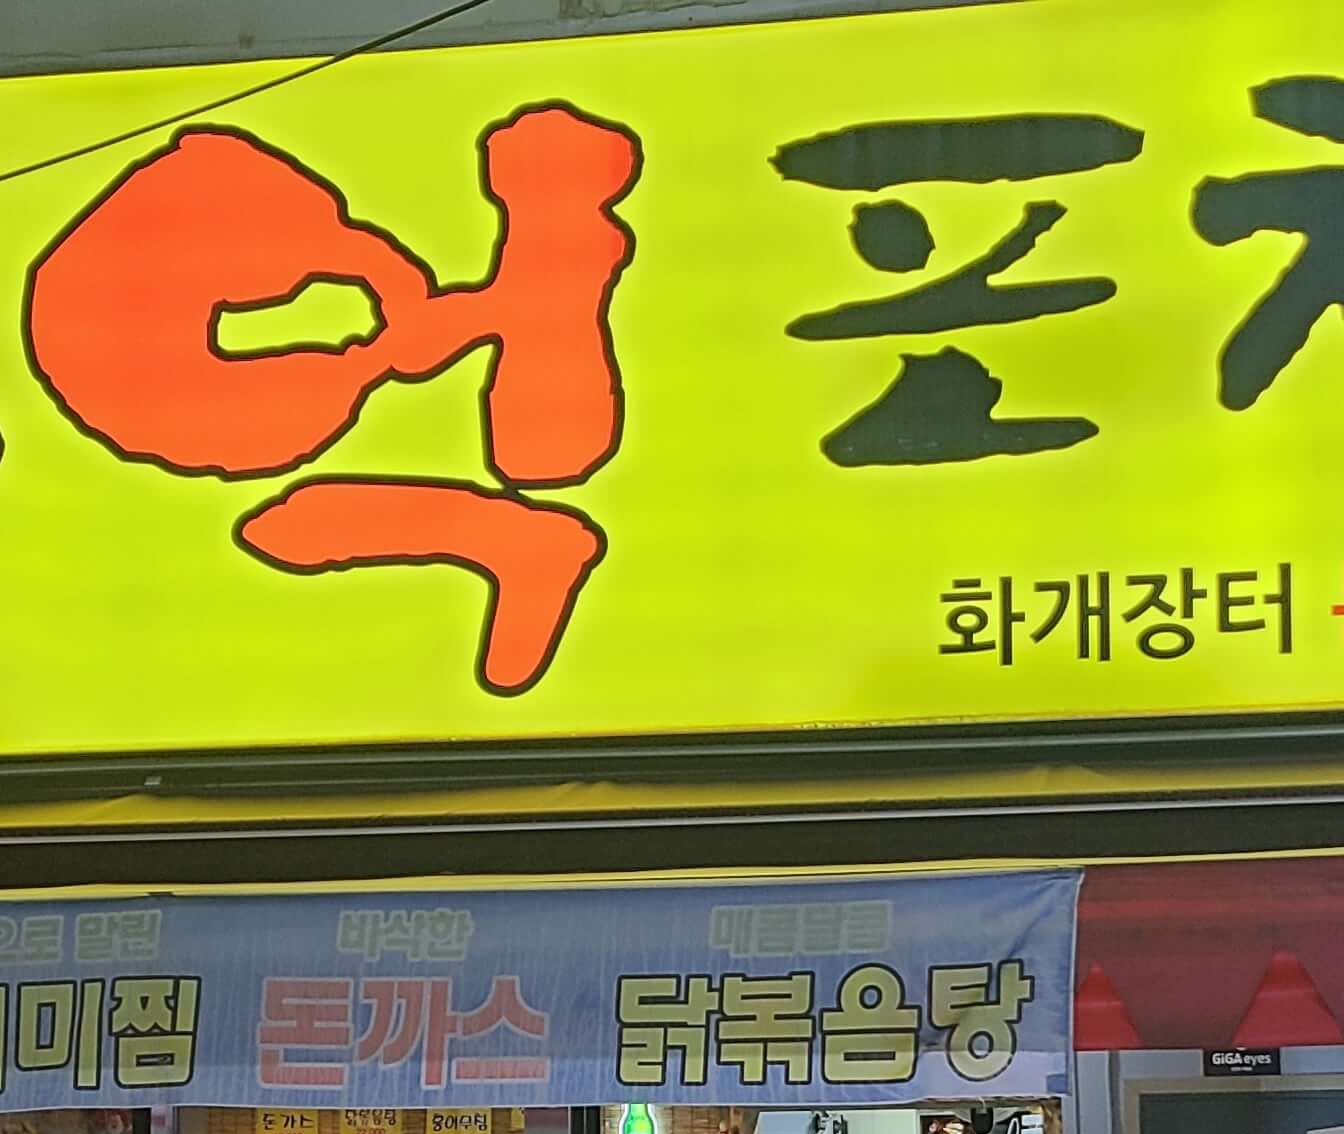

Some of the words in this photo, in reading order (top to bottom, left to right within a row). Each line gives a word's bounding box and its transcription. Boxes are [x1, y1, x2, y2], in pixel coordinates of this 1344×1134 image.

[940, 563, 1293, 666] 화개장터
[74, 909, 162, 962] 말린
[336, 907, 475, 961] 바삭한
[258, 975, 551, 1090] 돈까스
[616, 958, 1035, 1086] 닭볶음탕
